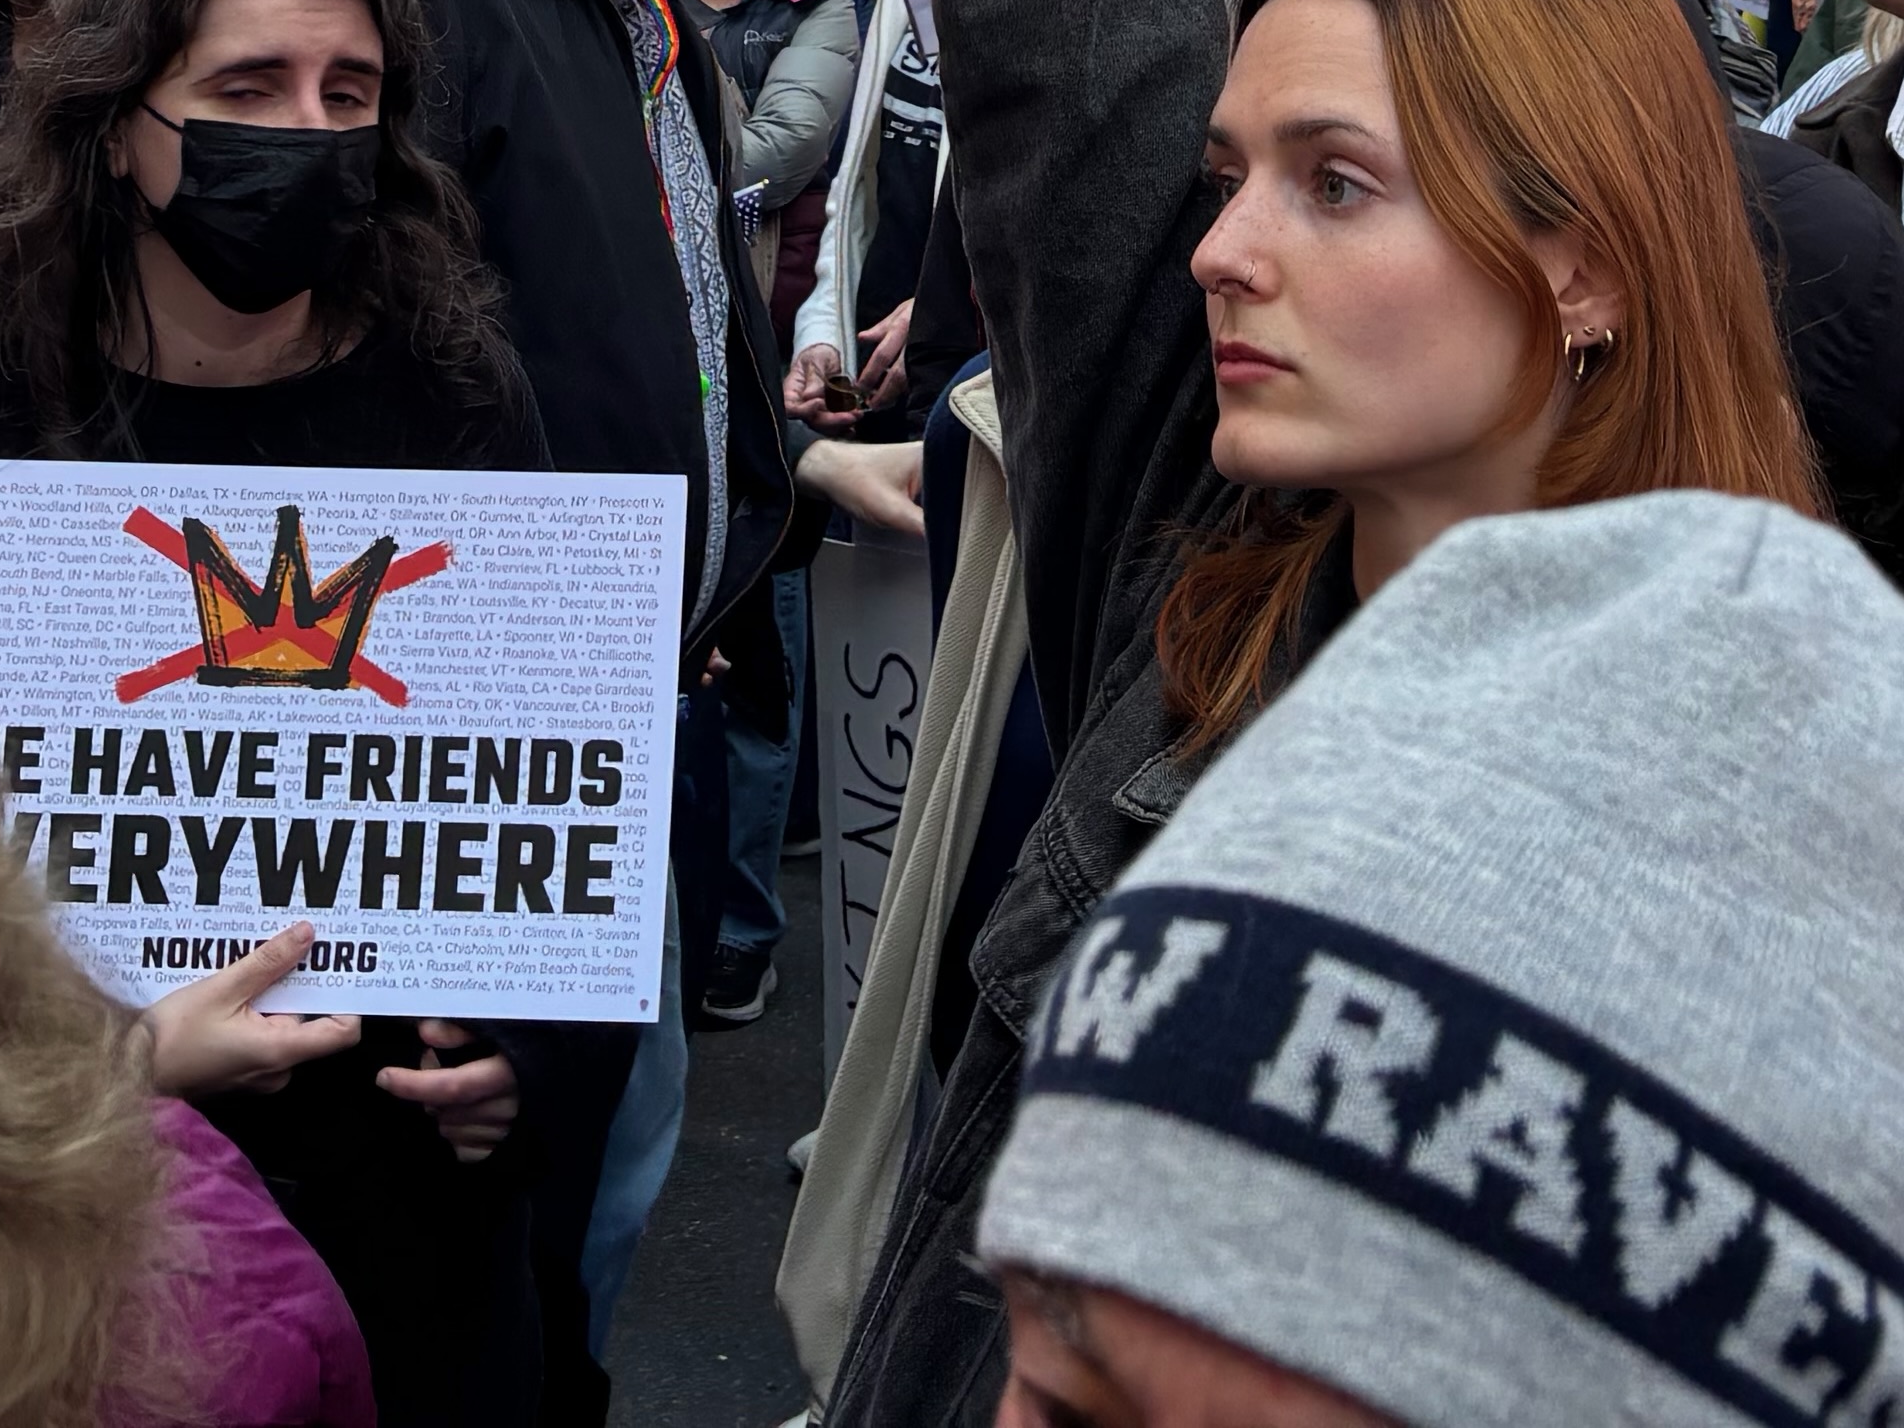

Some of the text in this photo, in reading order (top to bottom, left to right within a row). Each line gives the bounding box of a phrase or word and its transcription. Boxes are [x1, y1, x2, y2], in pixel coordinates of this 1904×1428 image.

[69, 727, 278, 799] HAVE
[306, 734, 623, 808] FRIENDS
[8, 810, 618, 915] ERYWHERE
[140, 934, 378, 976] NOKIN.ORG
